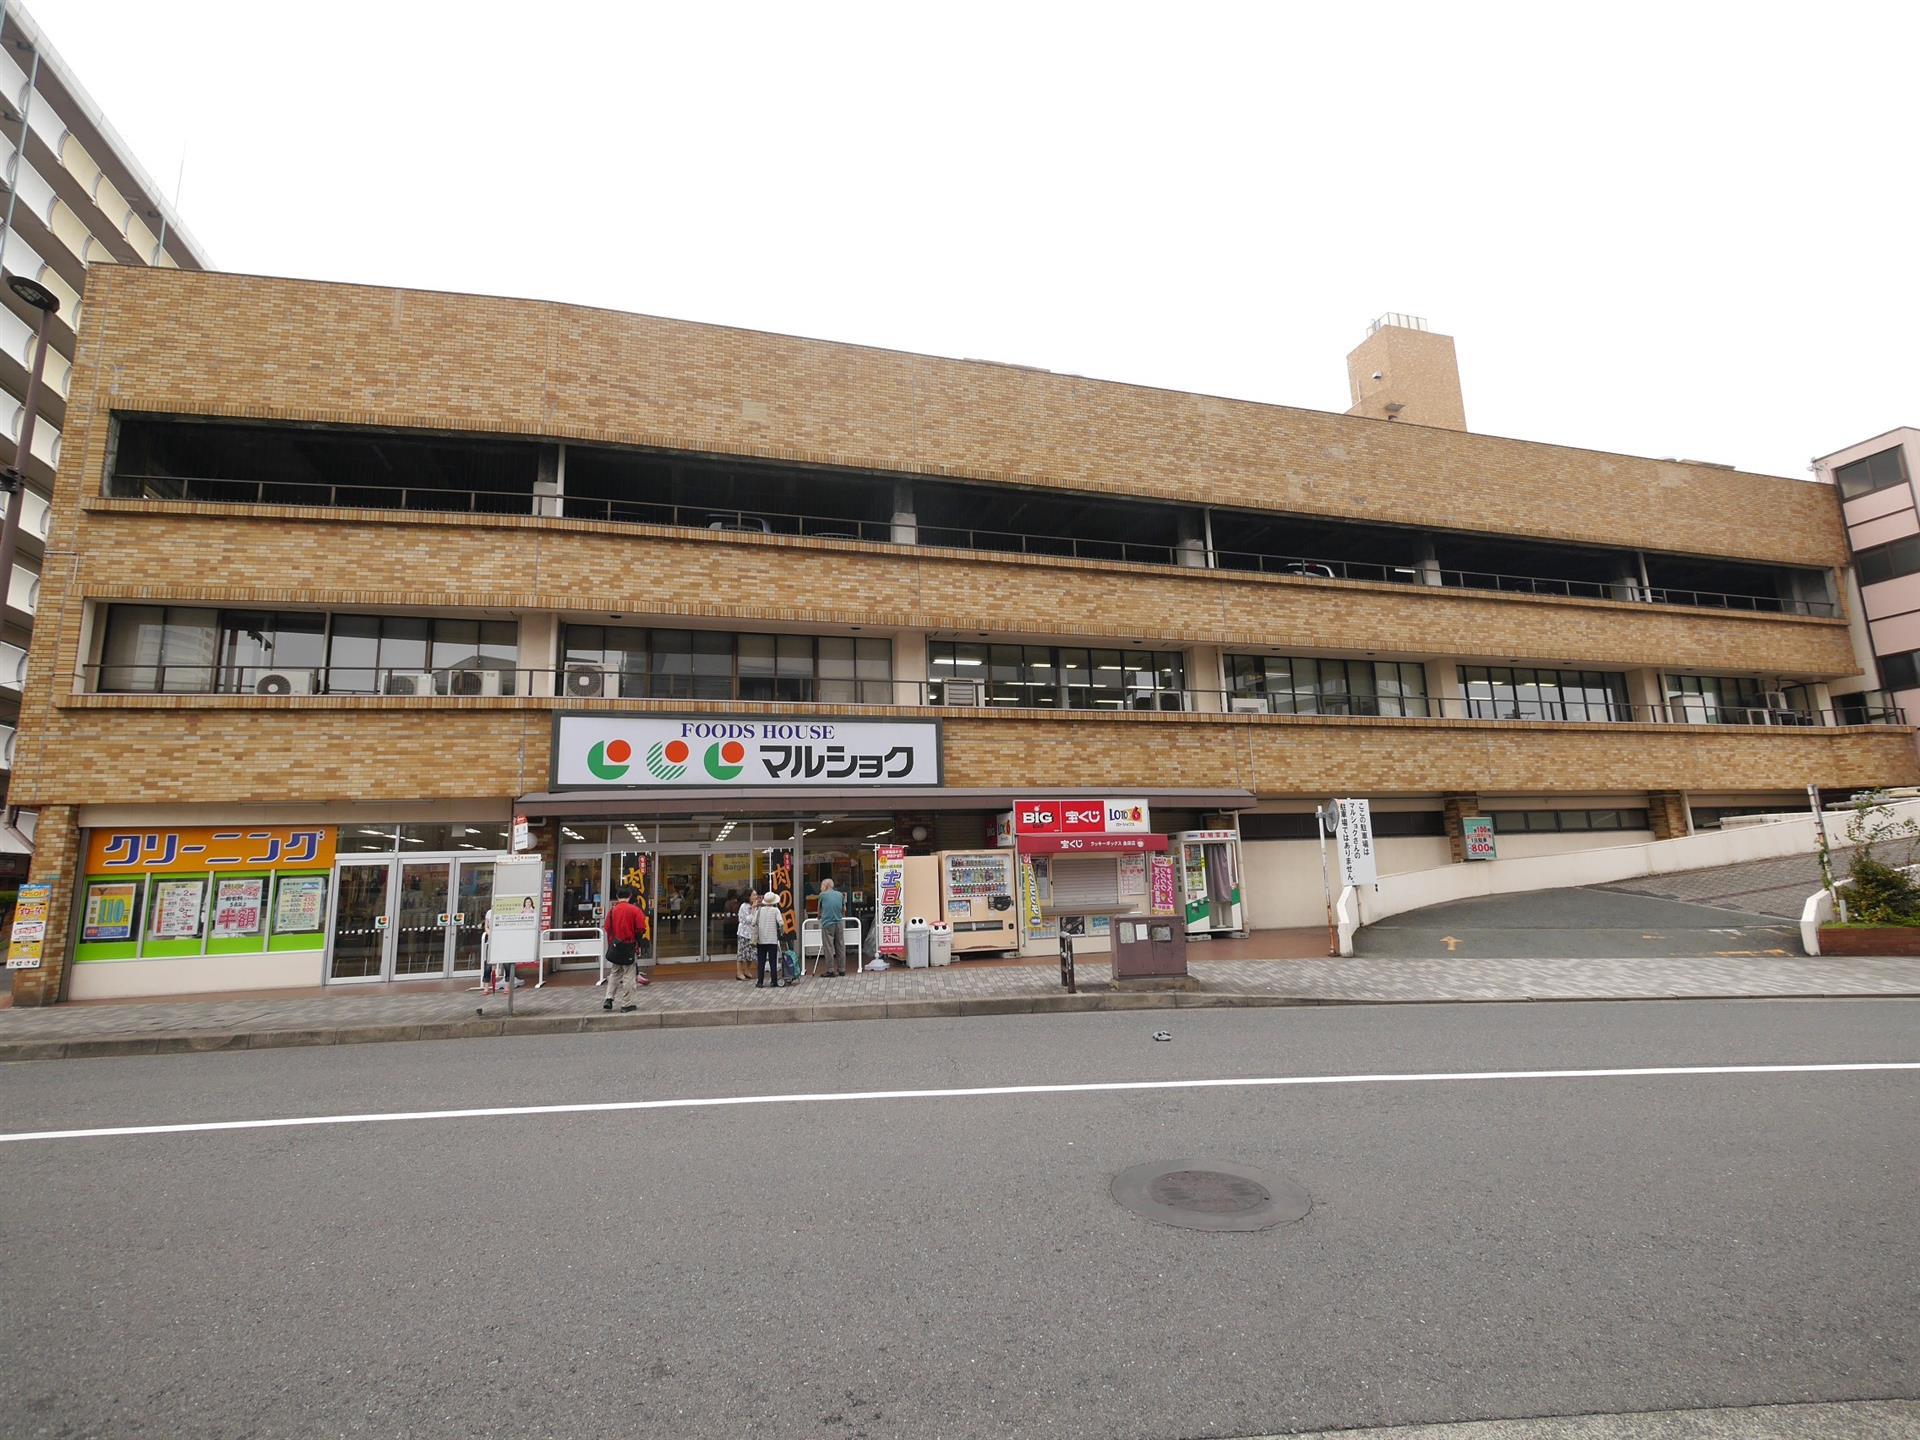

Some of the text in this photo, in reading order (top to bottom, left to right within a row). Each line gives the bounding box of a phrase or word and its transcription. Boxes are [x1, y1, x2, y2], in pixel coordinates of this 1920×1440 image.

[680, 722, 836, 741] FOODS HOUSE
[759, 745, 914, 779] マルショク
[1065, 809, 1101, 825] 宝くじ
[1109, 806, 1143, 823] LOTO 6
[1348, 802, 1362, 860] マルショクさんの
[1358, 802, 1371, 856] ここの駐車場は
[102, 829, 326, 867] クリーニング
[1060, 840, 1084, 849] 宝くじ
[881, 870, 902, 924] 土日祭
[218, 908, 258, 929] 半額
